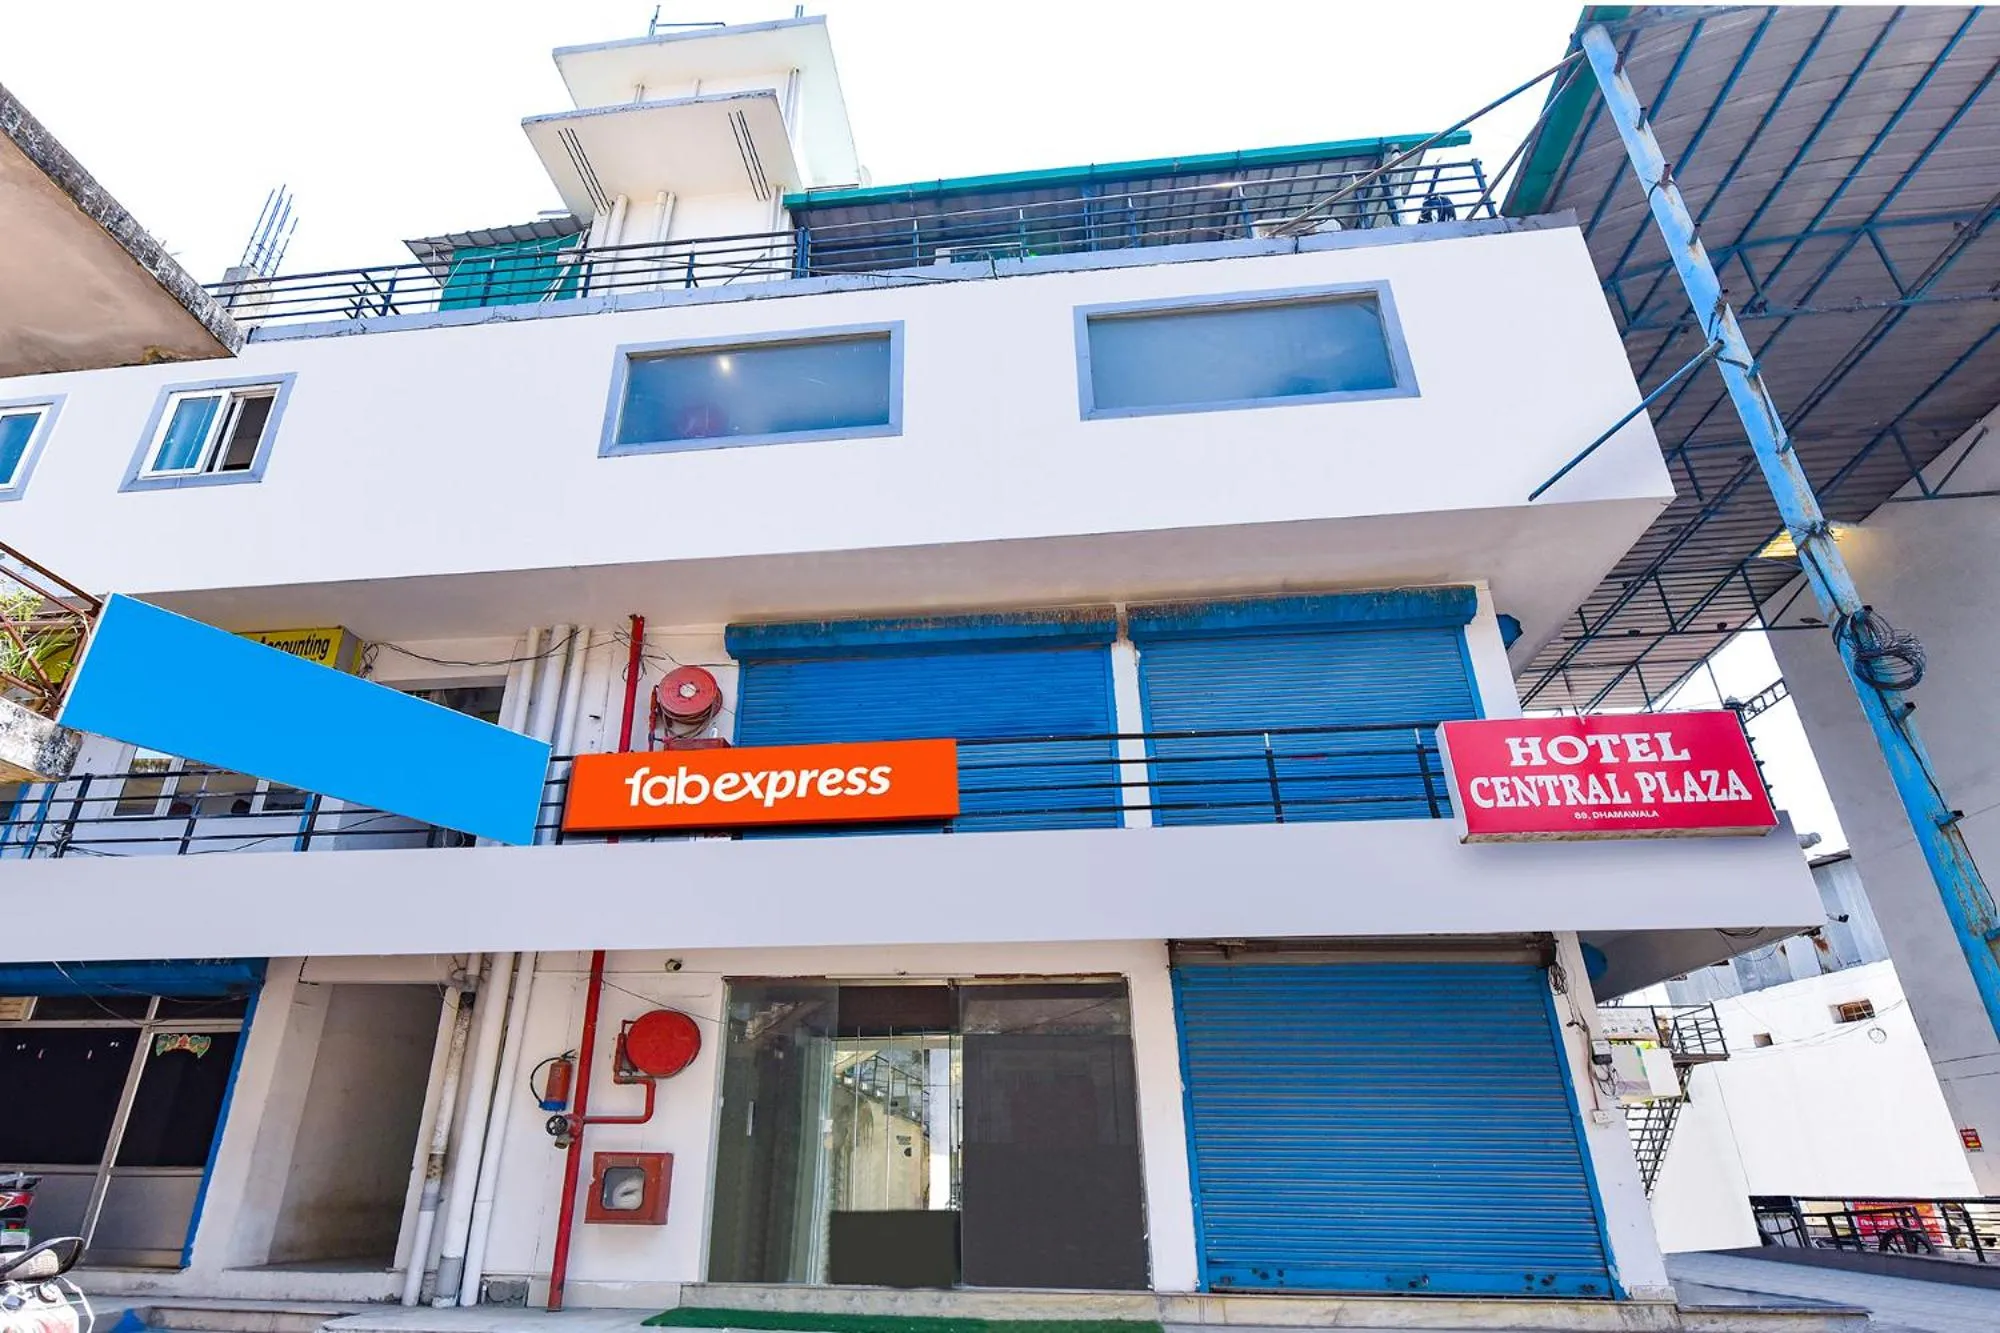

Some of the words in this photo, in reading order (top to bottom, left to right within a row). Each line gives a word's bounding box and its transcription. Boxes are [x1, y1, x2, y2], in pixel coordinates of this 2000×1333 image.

[1505, 733, 1690, 766] HOTEL
[1470, 774, 1629, 809] CENTRAL
[1635, 770, 1752, 804] PLAZA
[1592, 810, 1660, 819] DHAMAWALA
